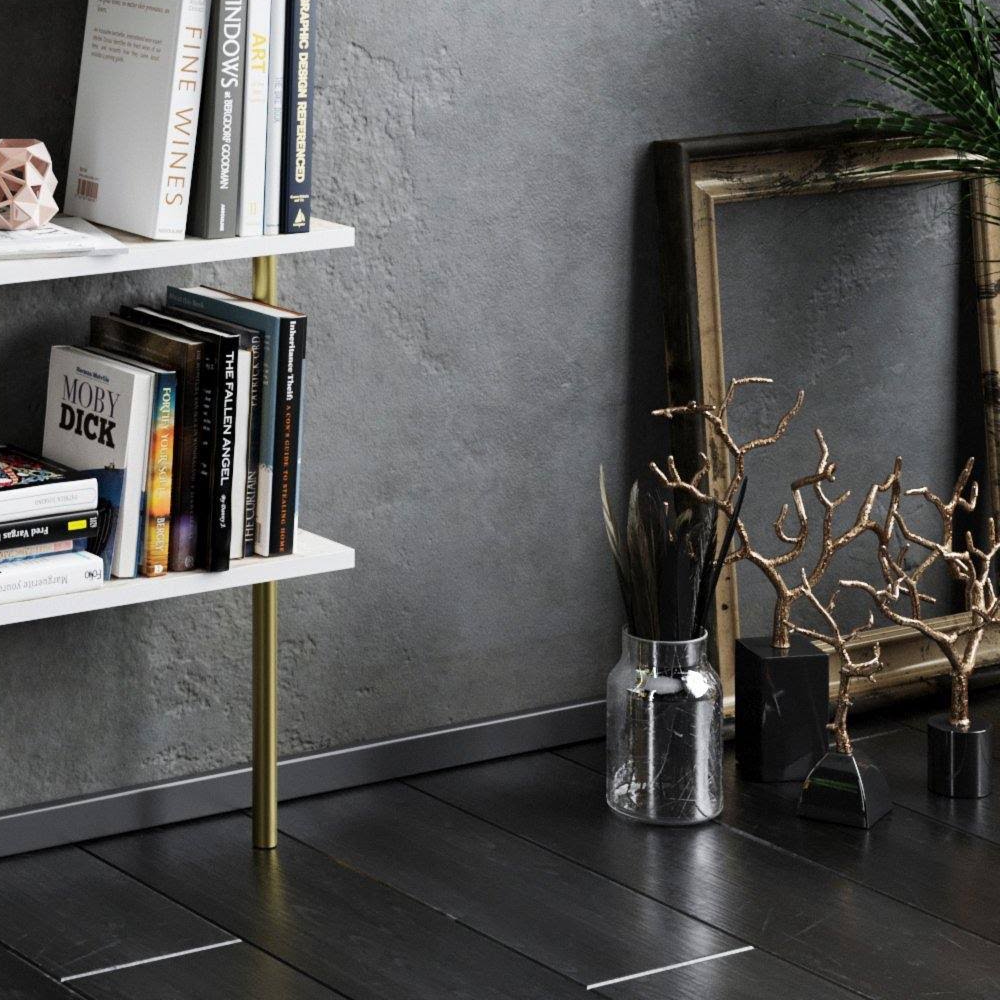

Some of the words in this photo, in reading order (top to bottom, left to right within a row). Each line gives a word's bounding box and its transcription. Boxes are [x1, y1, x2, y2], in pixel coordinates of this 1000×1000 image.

[178, 26, 203, 92] FINE
[251, 33, 267, 73] ART
[297, 52, 309, 98] DESIGN
[222, 100, 233, 143] BERGDORF
[295, 102, 307, 183] REFERENCED
[165, 107, 194, 206] WINES
[220, 145, 230, 190] GOODMAN
[225, 351, 235, 379] THE
[287, 320, 297, 373] Inheritance
[62, 374, 121, 418] MOBY
[160, 387, 172, 431] FORTIFY
[222, 382, 234, 435] FALLEN
[58, 402, 116, 449] DICK
[158, 433, 169, 462] YOUR
[220, 437, 232, 486] ANGEL
[282, 470, 288, 481] TO
[245, 471, 256, 521] CURTAIN
[280, 484, 288, 525] STEALING
[3, 528, 30, 541] Vargas
[31, 526, 49, 537] Fred
[156, 517, 166, 552] BERGEY
[245, 521, 254, 543] THE
[23, 575, 68, 590] Marguerite
